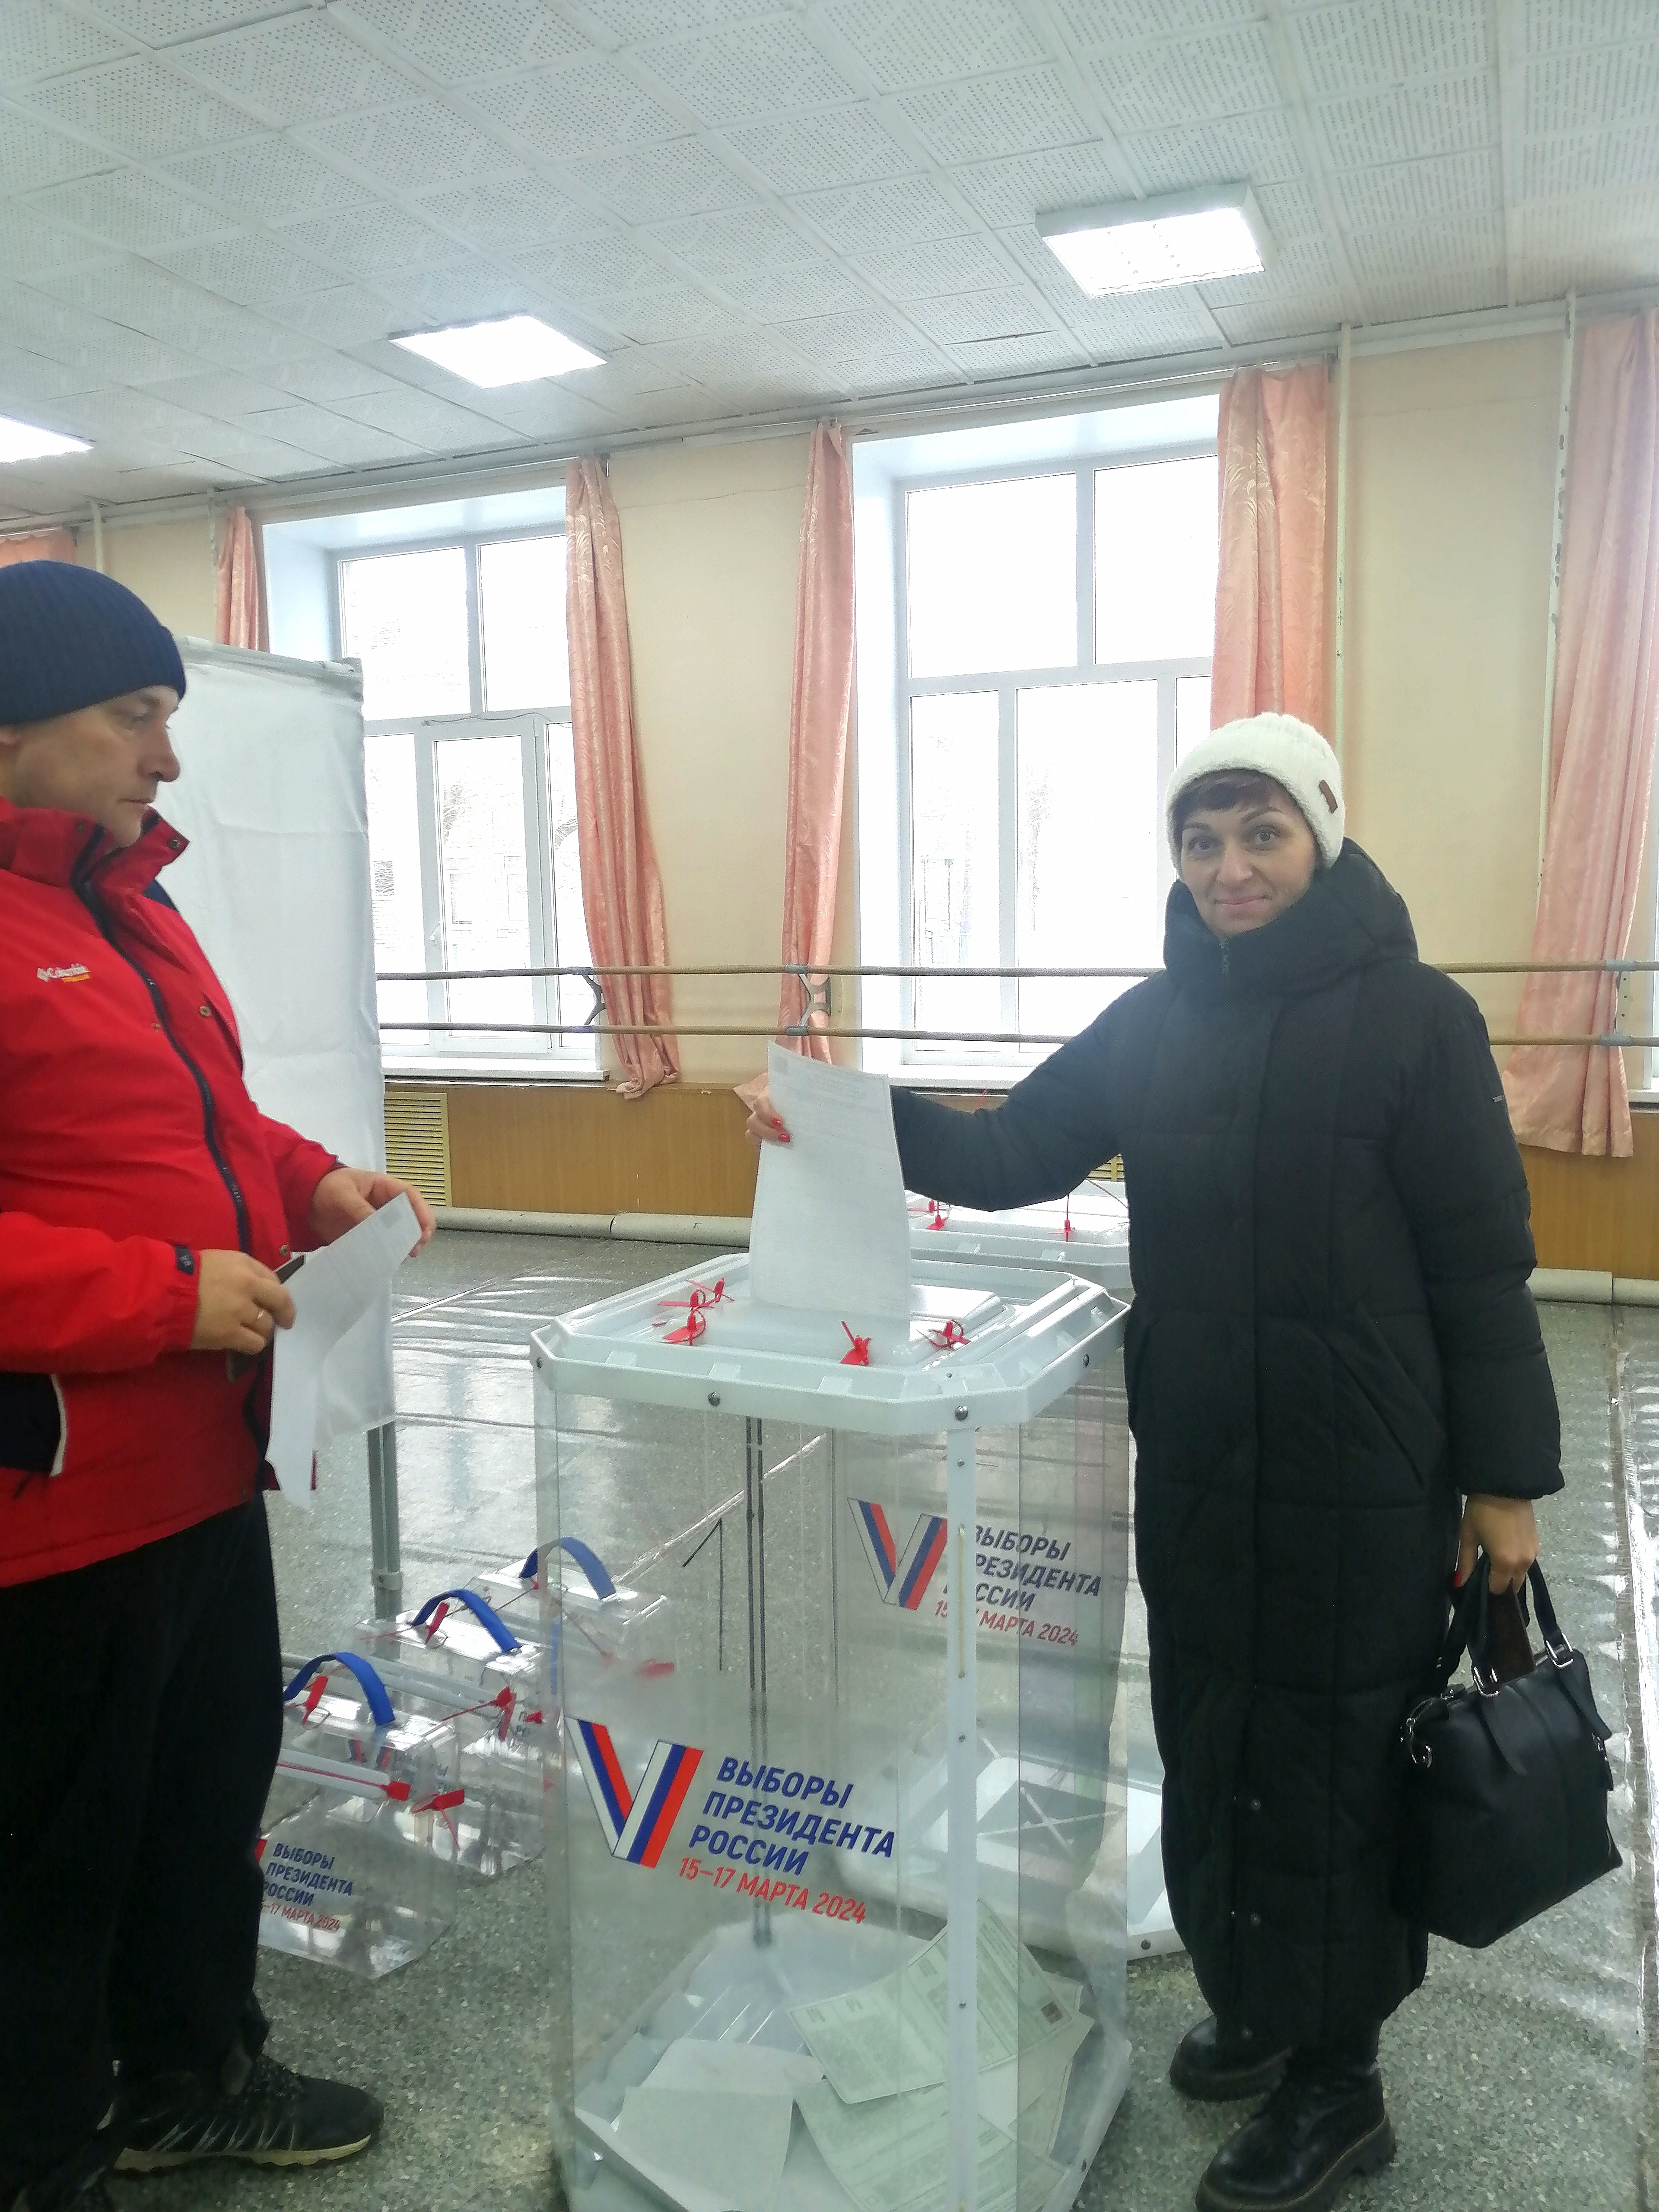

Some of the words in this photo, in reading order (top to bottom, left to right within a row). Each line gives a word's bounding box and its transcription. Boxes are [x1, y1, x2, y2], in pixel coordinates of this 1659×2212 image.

[976, 1553, 1101, 1596] РЕЗИДЕНТА
[943, 1582, 1036, 1611] ССИИ
[979, 1611, 1034, 1637] МАРТА
[1037, 1623, 1078, 1646] 2024
[717, 1756, 854, 1808] ВЫБОРЫ
[702, 1790, 895, 1858] ПРЕЗИДЕНТА
[273, 1843, 335, 1870] ВЫБОРЫ
[689, 1825, 809, 1875] РОССИИ
[266, 1862, 352, 1896] ПРЕЗИДЕНТА
[736, 1873, 808, 1910] МАРТА
[812, 1893, 866, 1924] 2024
[281, 1906, 315, 1924] МАРТА
[315, 1914, 340, 1931] 2024
